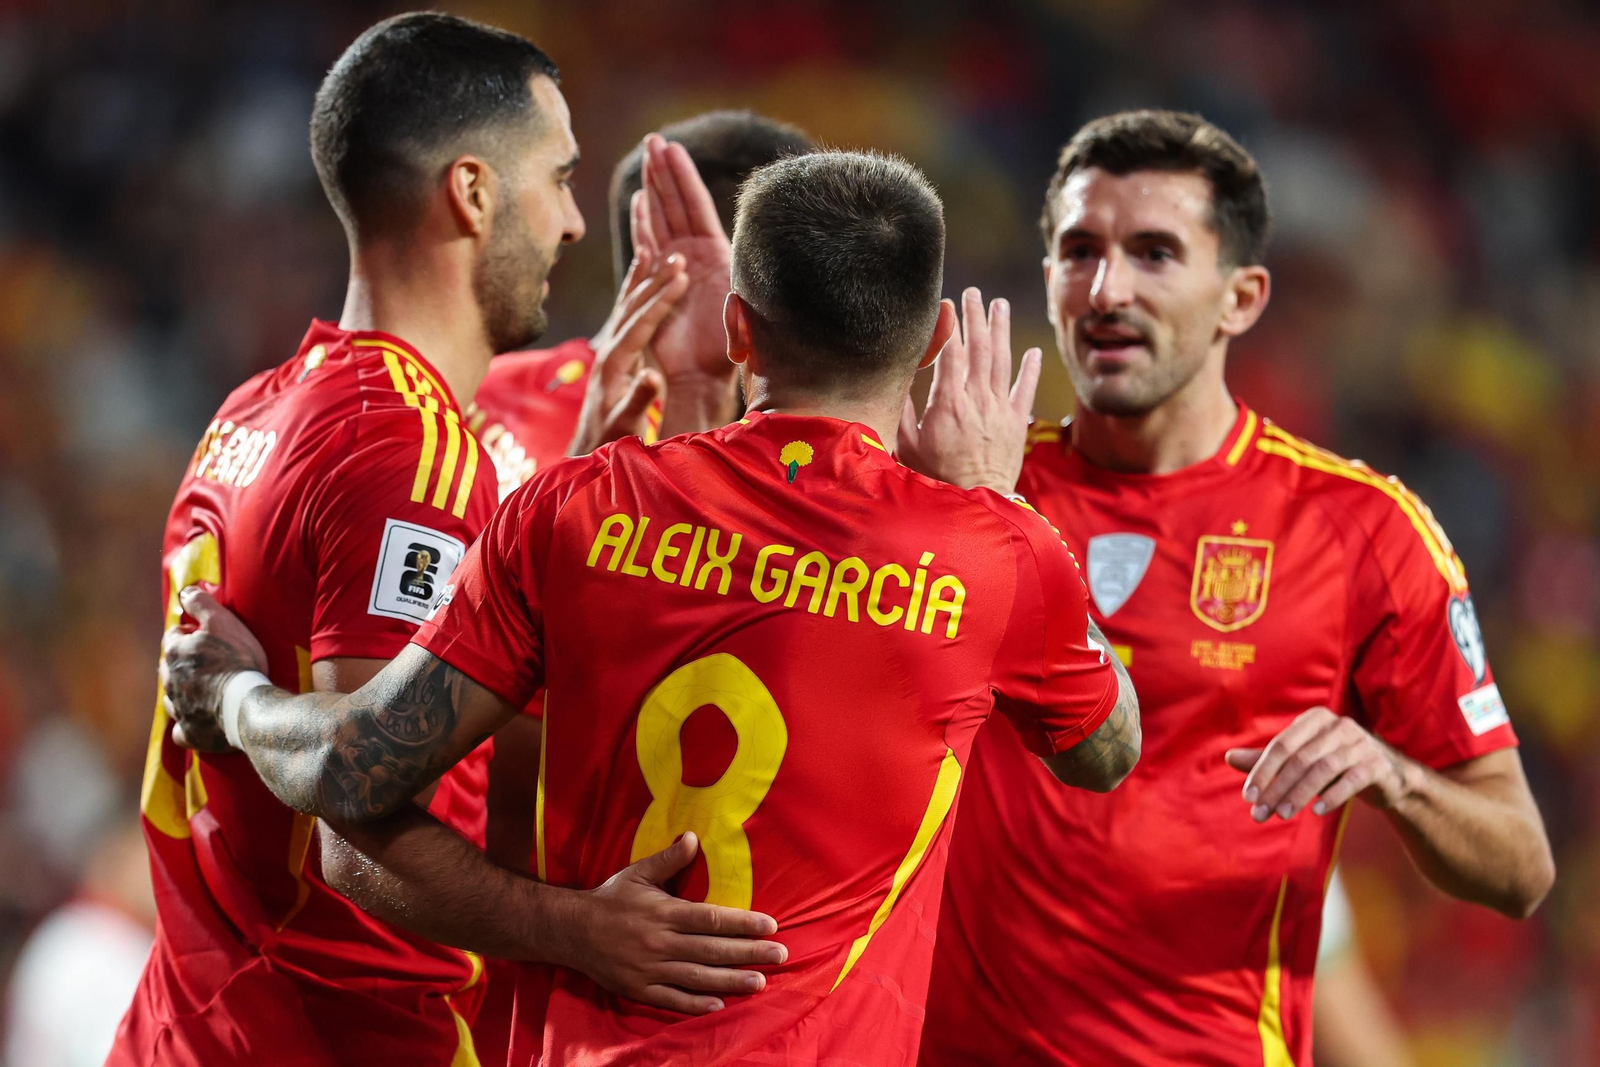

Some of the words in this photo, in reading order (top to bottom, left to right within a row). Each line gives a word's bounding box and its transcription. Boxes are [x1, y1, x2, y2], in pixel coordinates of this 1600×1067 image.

[397, 597, 429, 610] QUALIFIERS
[408, 585, 425, 596] FIFA
[586, 513, 743, 596] ALEIX
[750, 543, 967, 640] GARCÍA
[630, 652, 788, 911] 8
